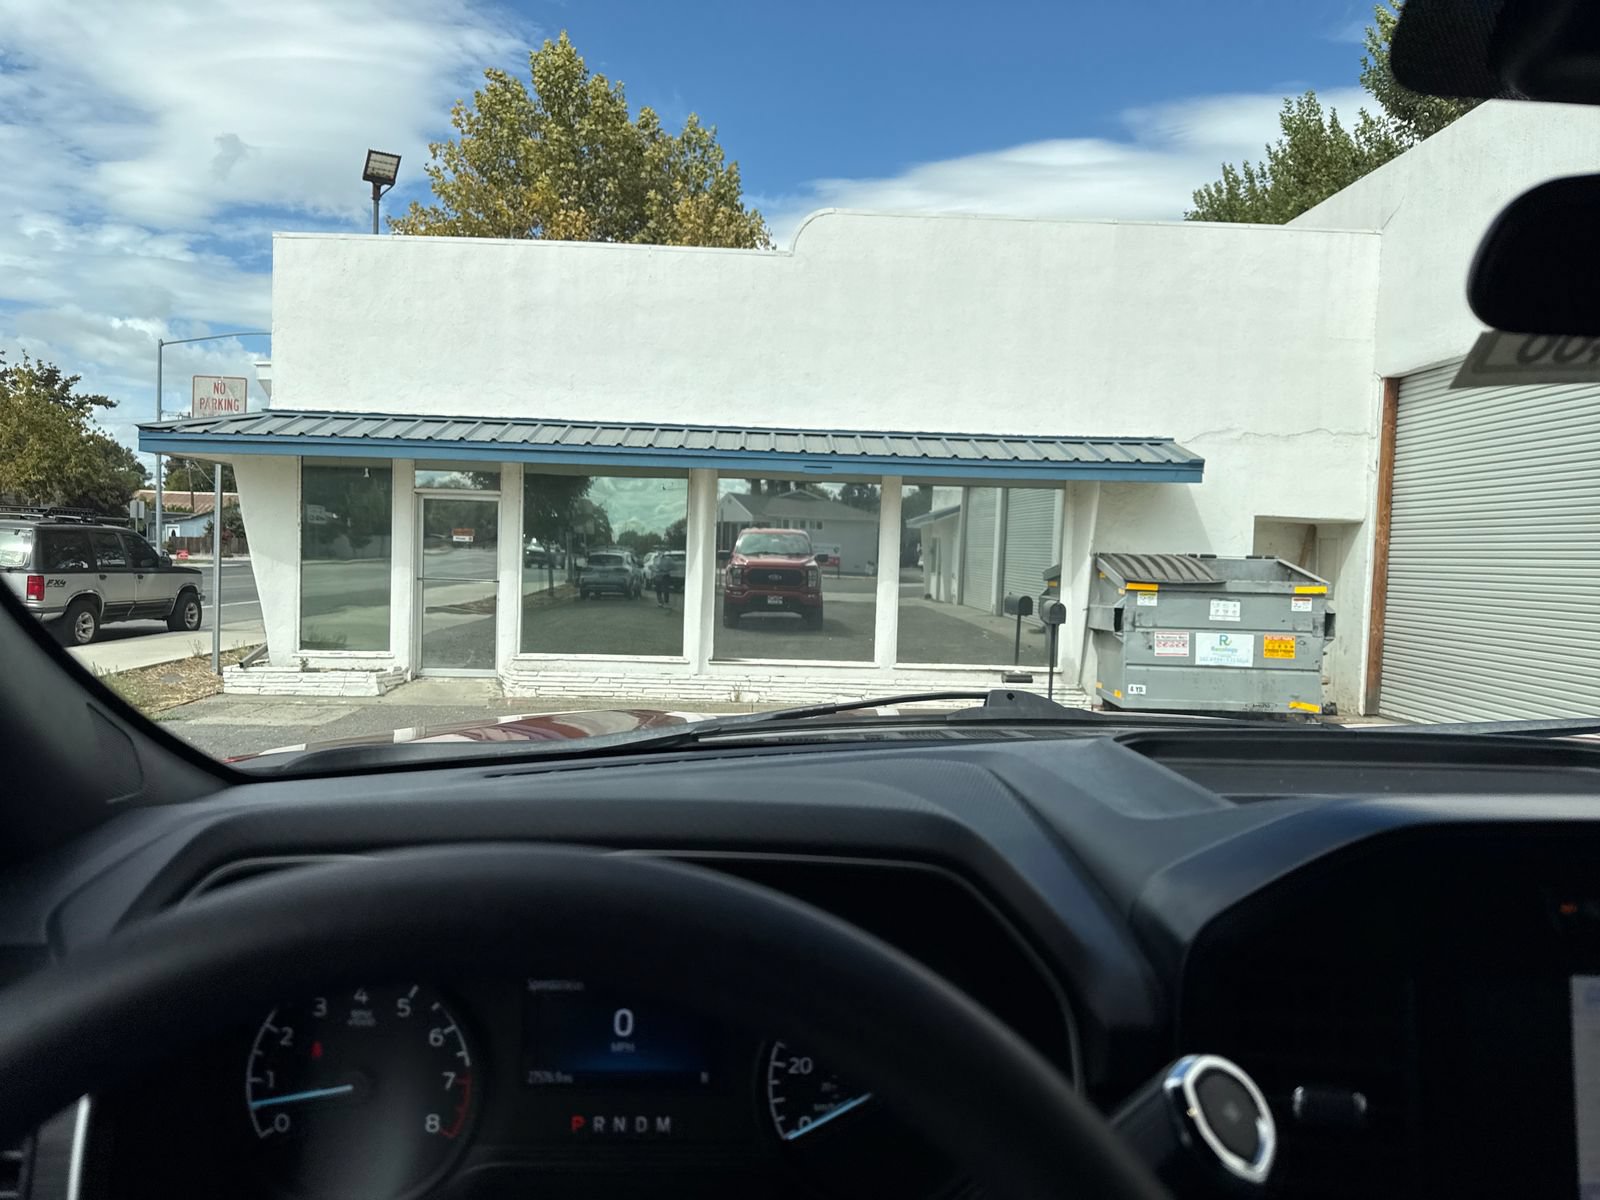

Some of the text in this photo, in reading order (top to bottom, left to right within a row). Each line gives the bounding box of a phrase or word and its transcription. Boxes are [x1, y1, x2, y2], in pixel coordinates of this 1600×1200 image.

[213, 382, 226, 395] NO
[199, 397, 240, 412] PARKING
[46, 578, 66, 587] FX4
[353, 988, 369, 1005] 4
[312, 996, 328, 1018] 3
[396, 998, 412, 1018] 5
[613, 1008, 635, 1038] 0
[279, 1027, 294, 1047] 2
[428, 1028, 445, 1048] 6
[787, 1056, 814, 1075] 20
[265, 1069, 276, 1089] 1
[442, 1071, 457, 1091] 7
[273, 1113, 291, 1133] 0
[424, 1113, 441, 1133] 8
[569, 1114, 671, 1133] P R N D M
